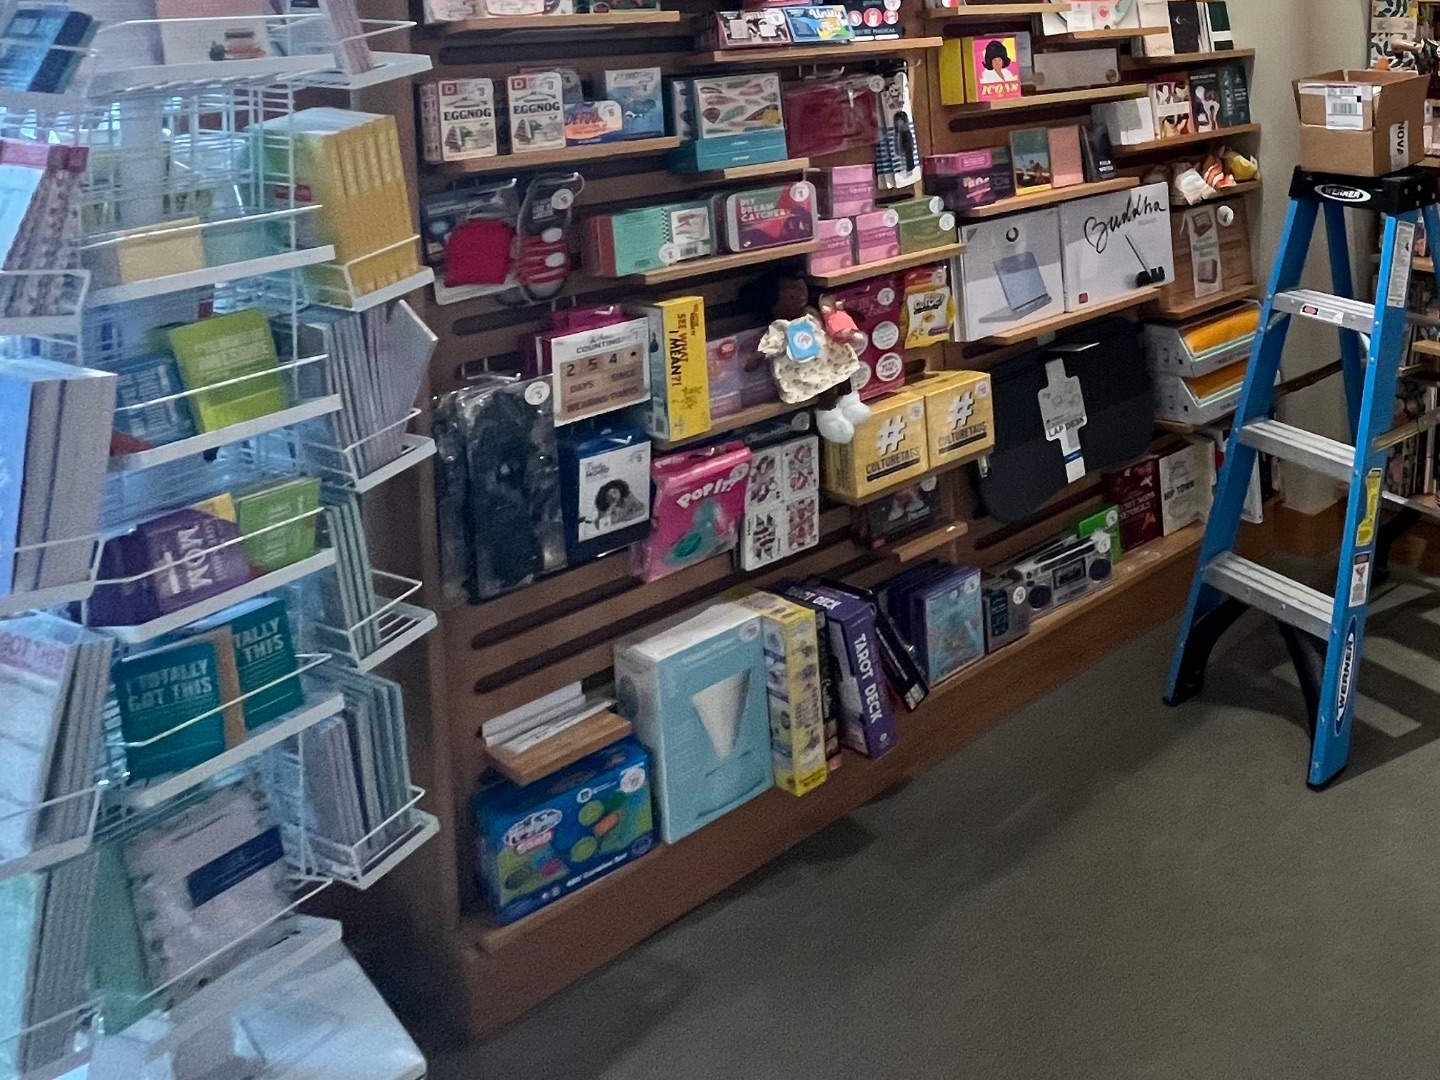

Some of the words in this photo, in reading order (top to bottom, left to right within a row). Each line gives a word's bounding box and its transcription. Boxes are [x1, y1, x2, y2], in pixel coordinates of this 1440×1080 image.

[443, 107, 493, 121] EGGNOG
[512, 101, 561, 115] EGGNOG
[740, 203, 775, 215] DREAM
[677, 313, 687, 330] SEE
[679, 332, 689, 363] WHAT
[566, 363, 575, 377] 2
[588, 358, 598, 371] 5
[608, 352, 618, 364] 4
[938, 421, 987, 447] CULTURETAGS
[865, 446, 921, 474] CULTURETAGS
[178, 525, 213, 590] MOM
[242, 633, 284, 664] THIS
[172, 676, 213, 698] THIS
[854, 633, 874, 680] TAROT
[864, 682, 883, 724] DECK
[1338, 640, 1354, 709] WERNER
